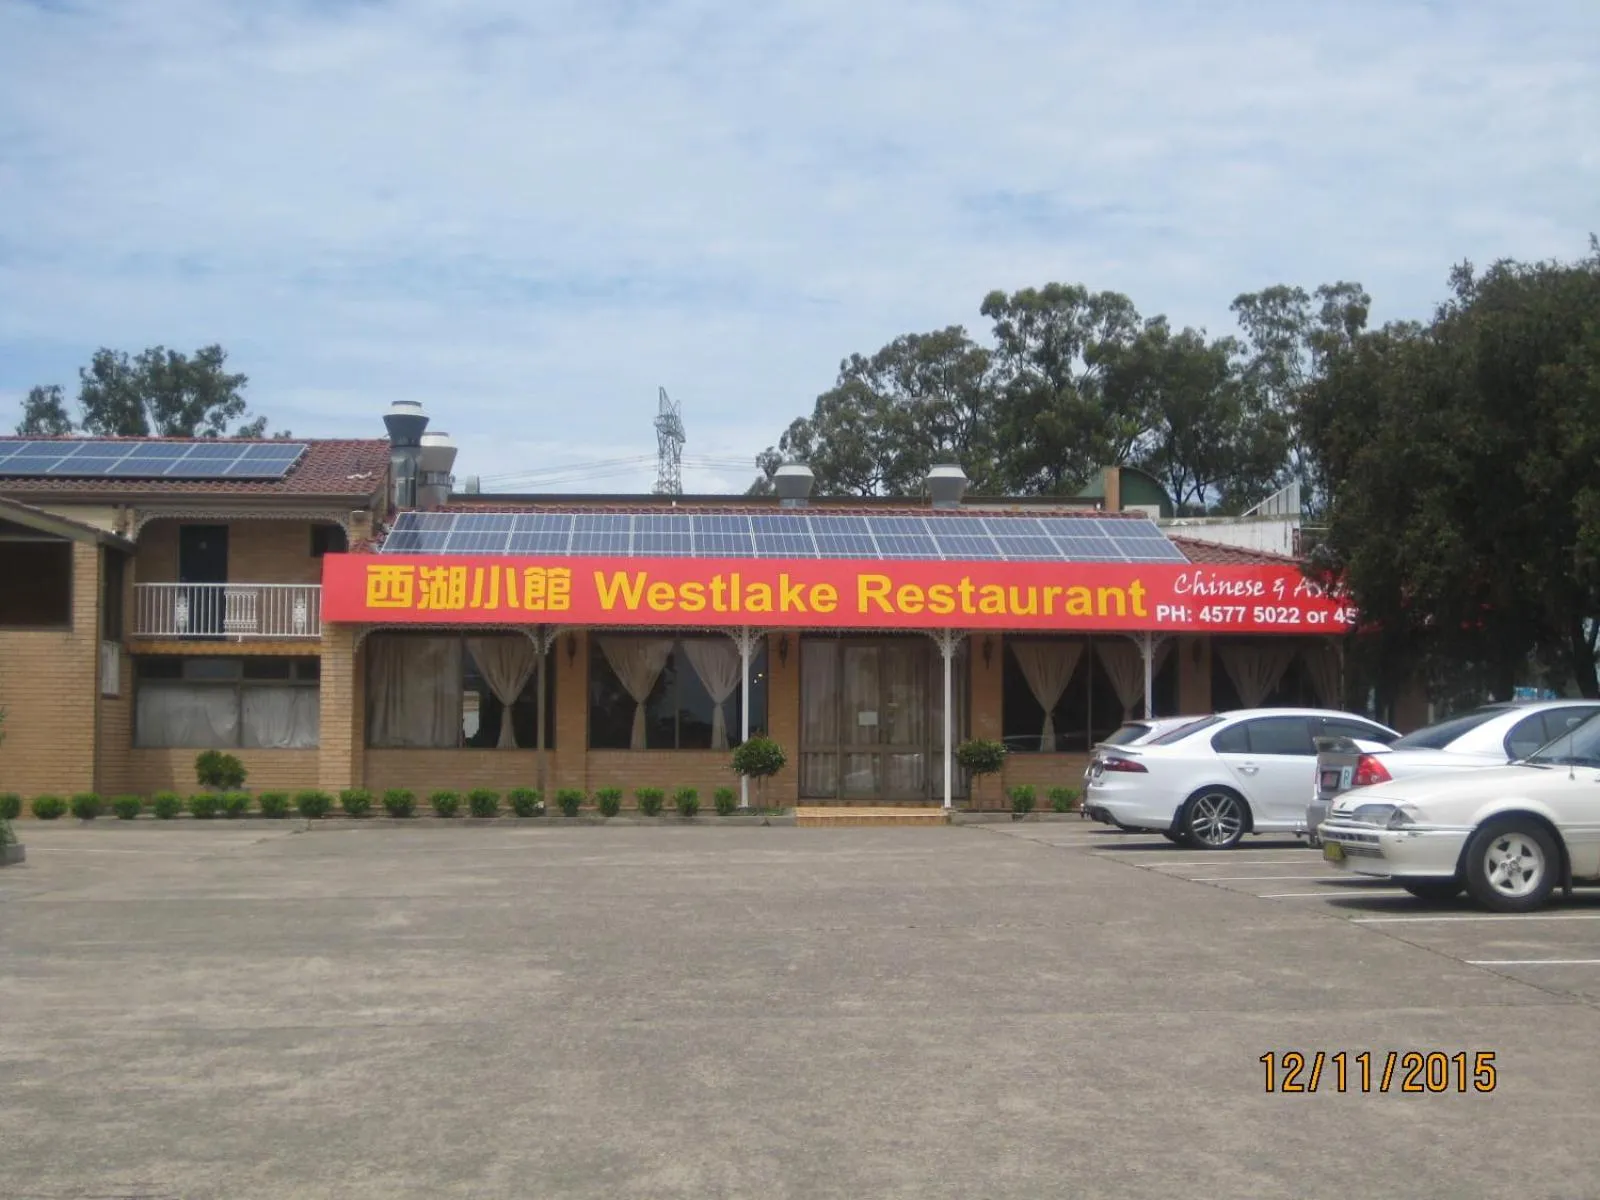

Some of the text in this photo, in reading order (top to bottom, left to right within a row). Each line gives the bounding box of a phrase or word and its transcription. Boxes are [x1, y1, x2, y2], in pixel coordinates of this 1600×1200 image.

[366, 564, 572, 611] 西湖小館
[595, 570, 1148, 618] Westlake Restaurant
[1174, 570, 1265, 597] Chinese
[1273, 577, 1285, 600] &
[1156, 604, 1193, 623] PH:
[1199, 606, 1246, 624] 4577
[1253, 606, 1301, 625] 5022
[1306, 611, 1328, 624] or
